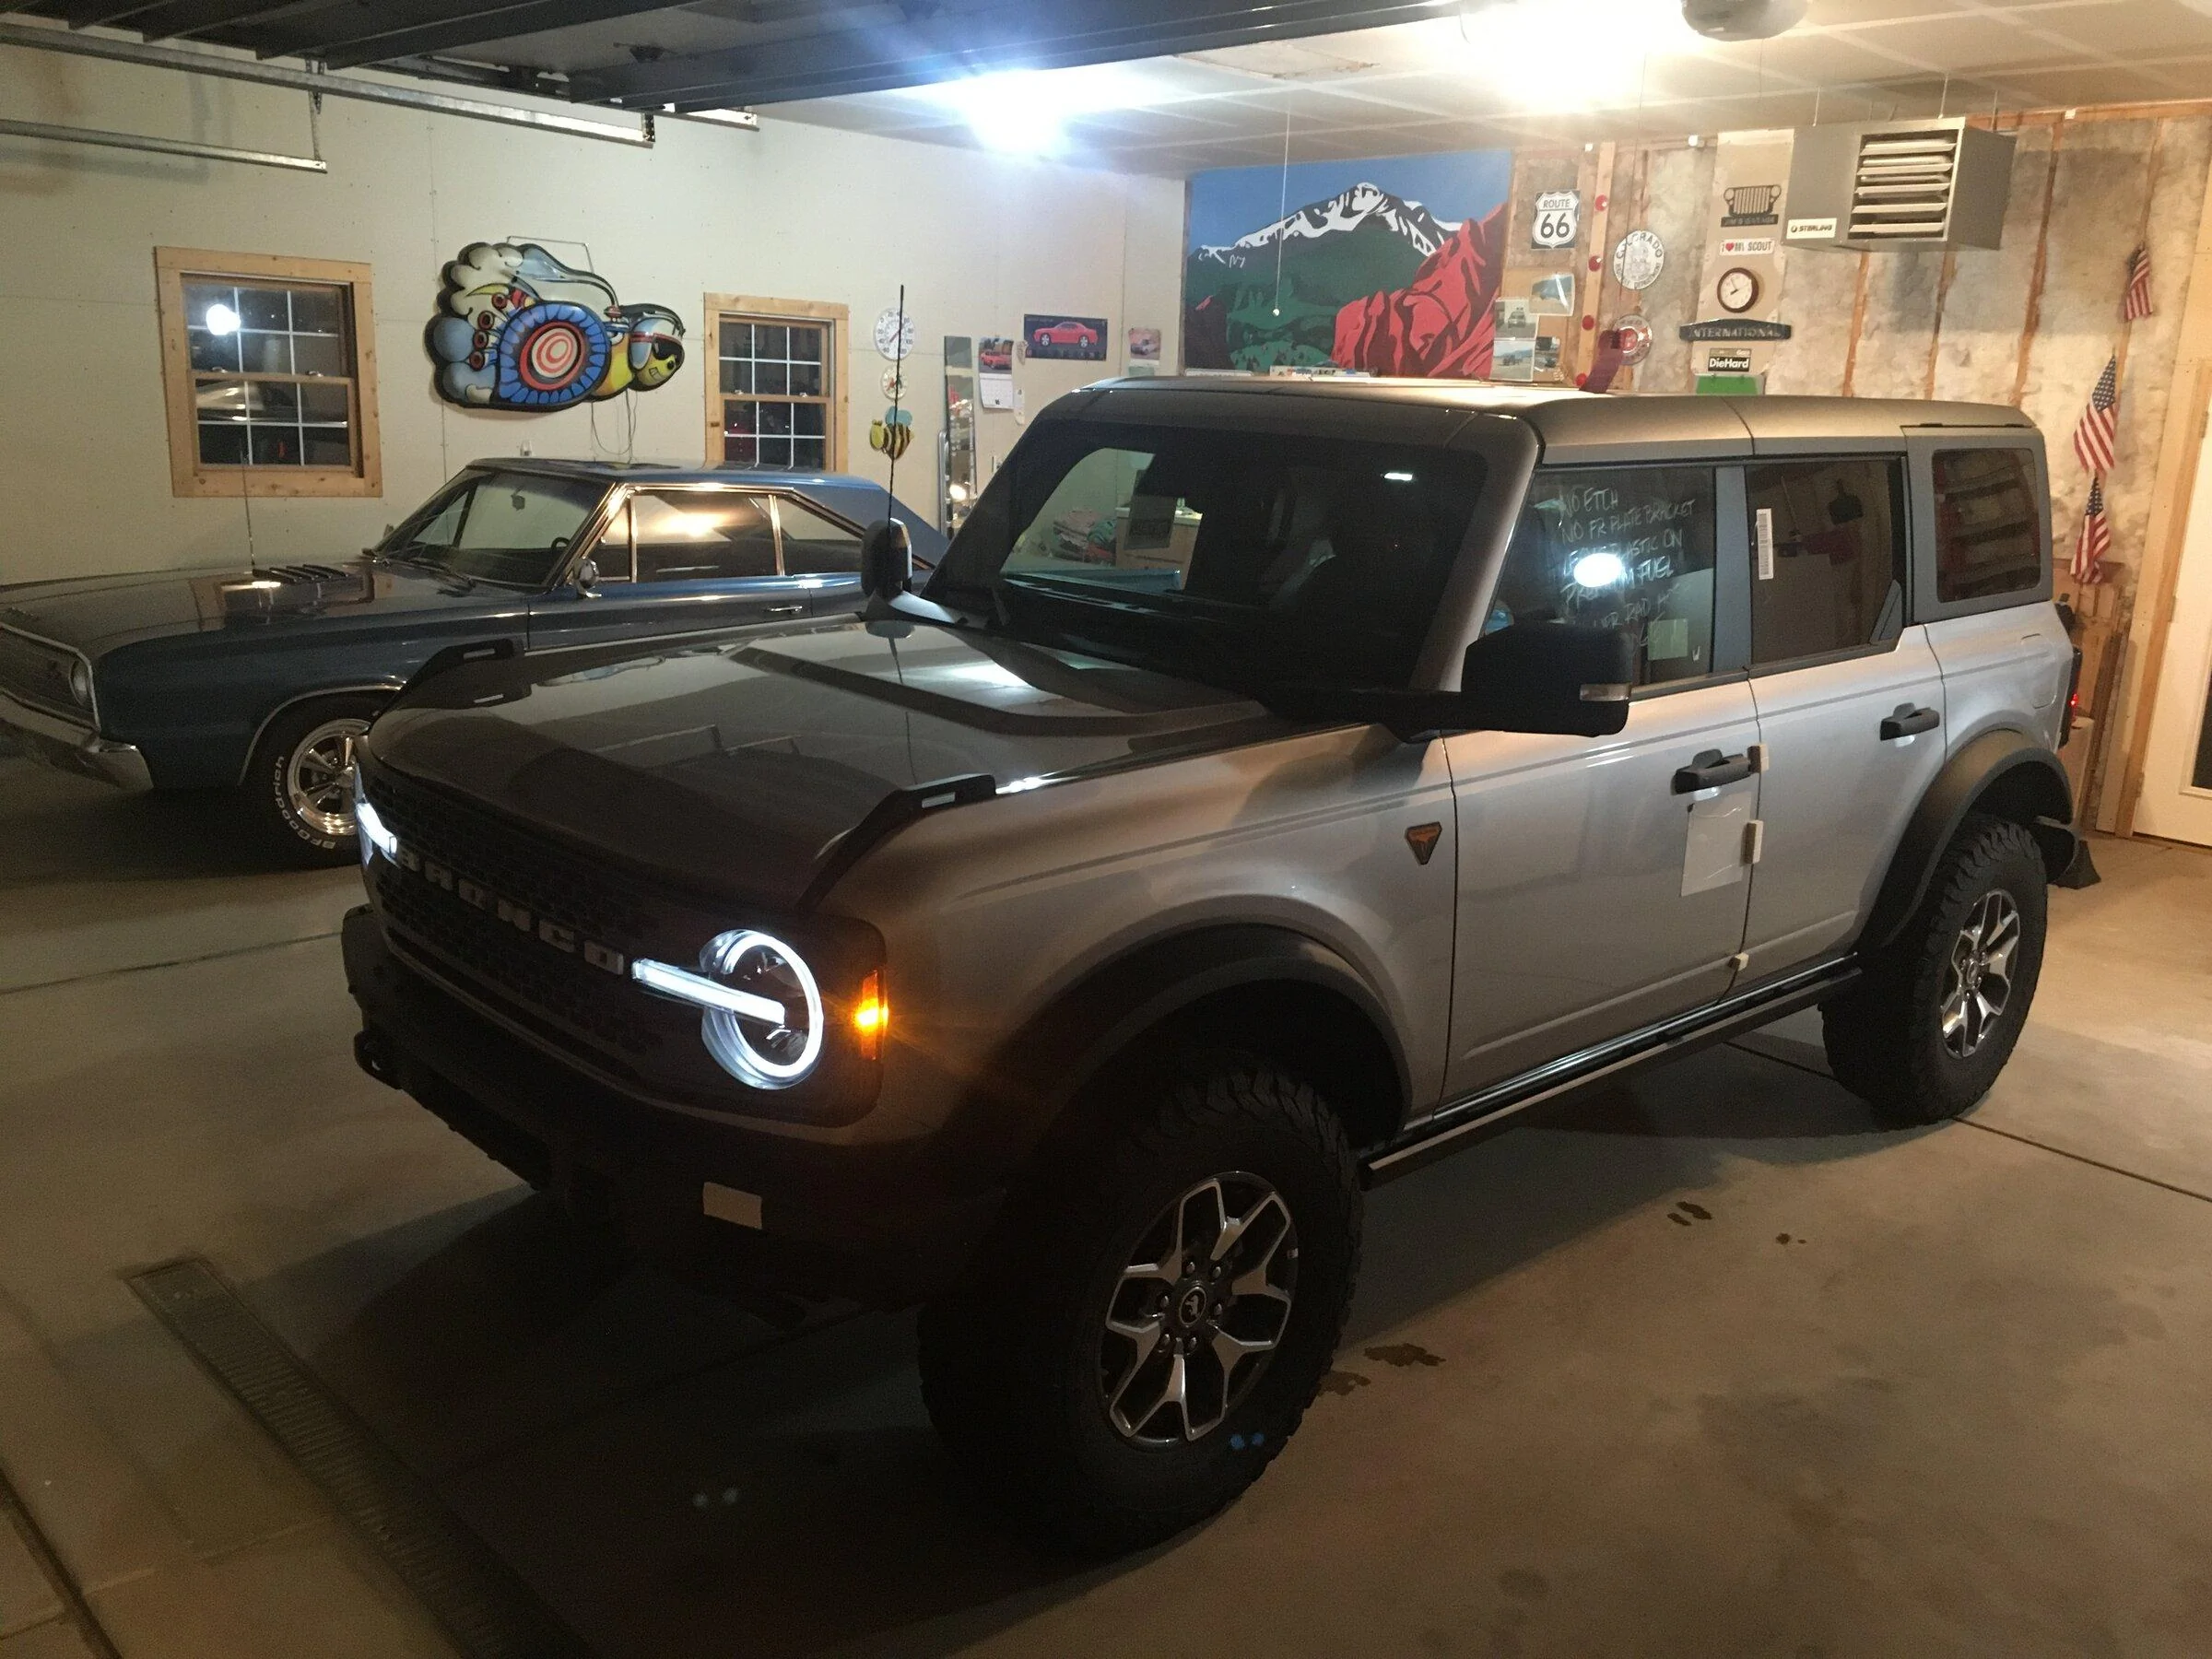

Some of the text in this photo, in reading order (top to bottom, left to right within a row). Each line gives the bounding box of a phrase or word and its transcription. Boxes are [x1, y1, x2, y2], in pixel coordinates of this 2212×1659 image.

[1543, 199, 1571, 208] ROUTE
[1540, 212, 1570, 239] 66
[1747, 241, 1771, 251] SCOUT
[1688, 325, 1782, 338] INTERNATIONAL
[1709, 358, 1749, 369] DieHard
[1584, 488, 1618, 512] ETCH
[1562, 522, 1584, 546] NO
[1663, 528, 1683, 548] ON
[1637, 554, 1674, 585] FUEL
[274, 756, 336, 850] BFGoodrich
[398, 844, 625, 976] BRONCO
